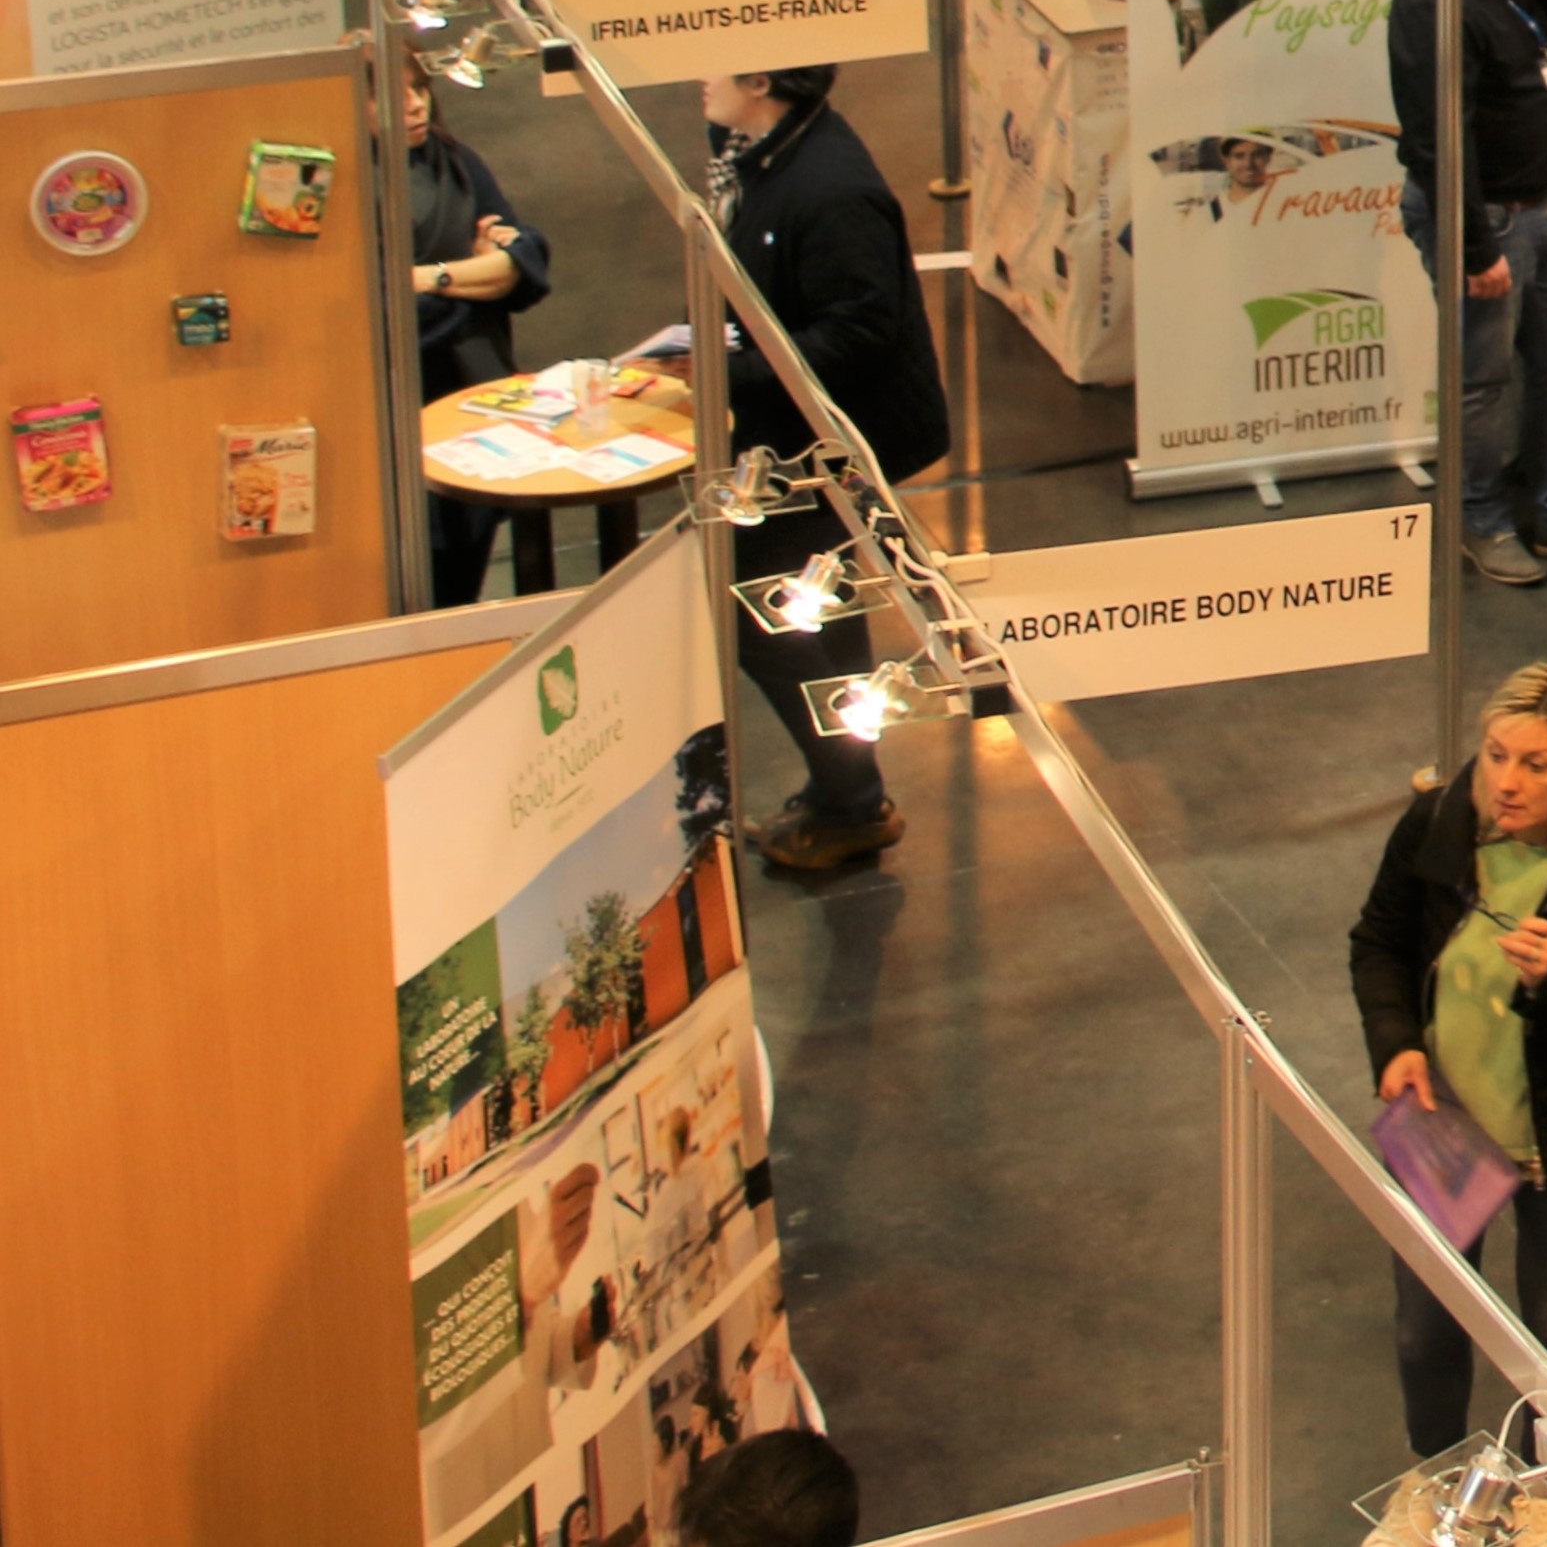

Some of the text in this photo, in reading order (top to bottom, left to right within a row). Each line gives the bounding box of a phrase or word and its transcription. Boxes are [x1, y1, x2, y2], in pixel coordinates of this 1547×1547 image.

[50, 19, 131, 53] LOGISTA
[591, 15, 651, 42] IFRIA
[1251, 166, 1403, 228] Travaux
[1314, 304, 1386, 348] AGRI
[1254, 343, 1387, 394] INTERIM
[1160, 397, 1404, 451] www.agri-interim.fr
[1390, 513, 1419, 540] 17
[1000, 571, 1394, 645] ABORATOIRE BODY NATURE
